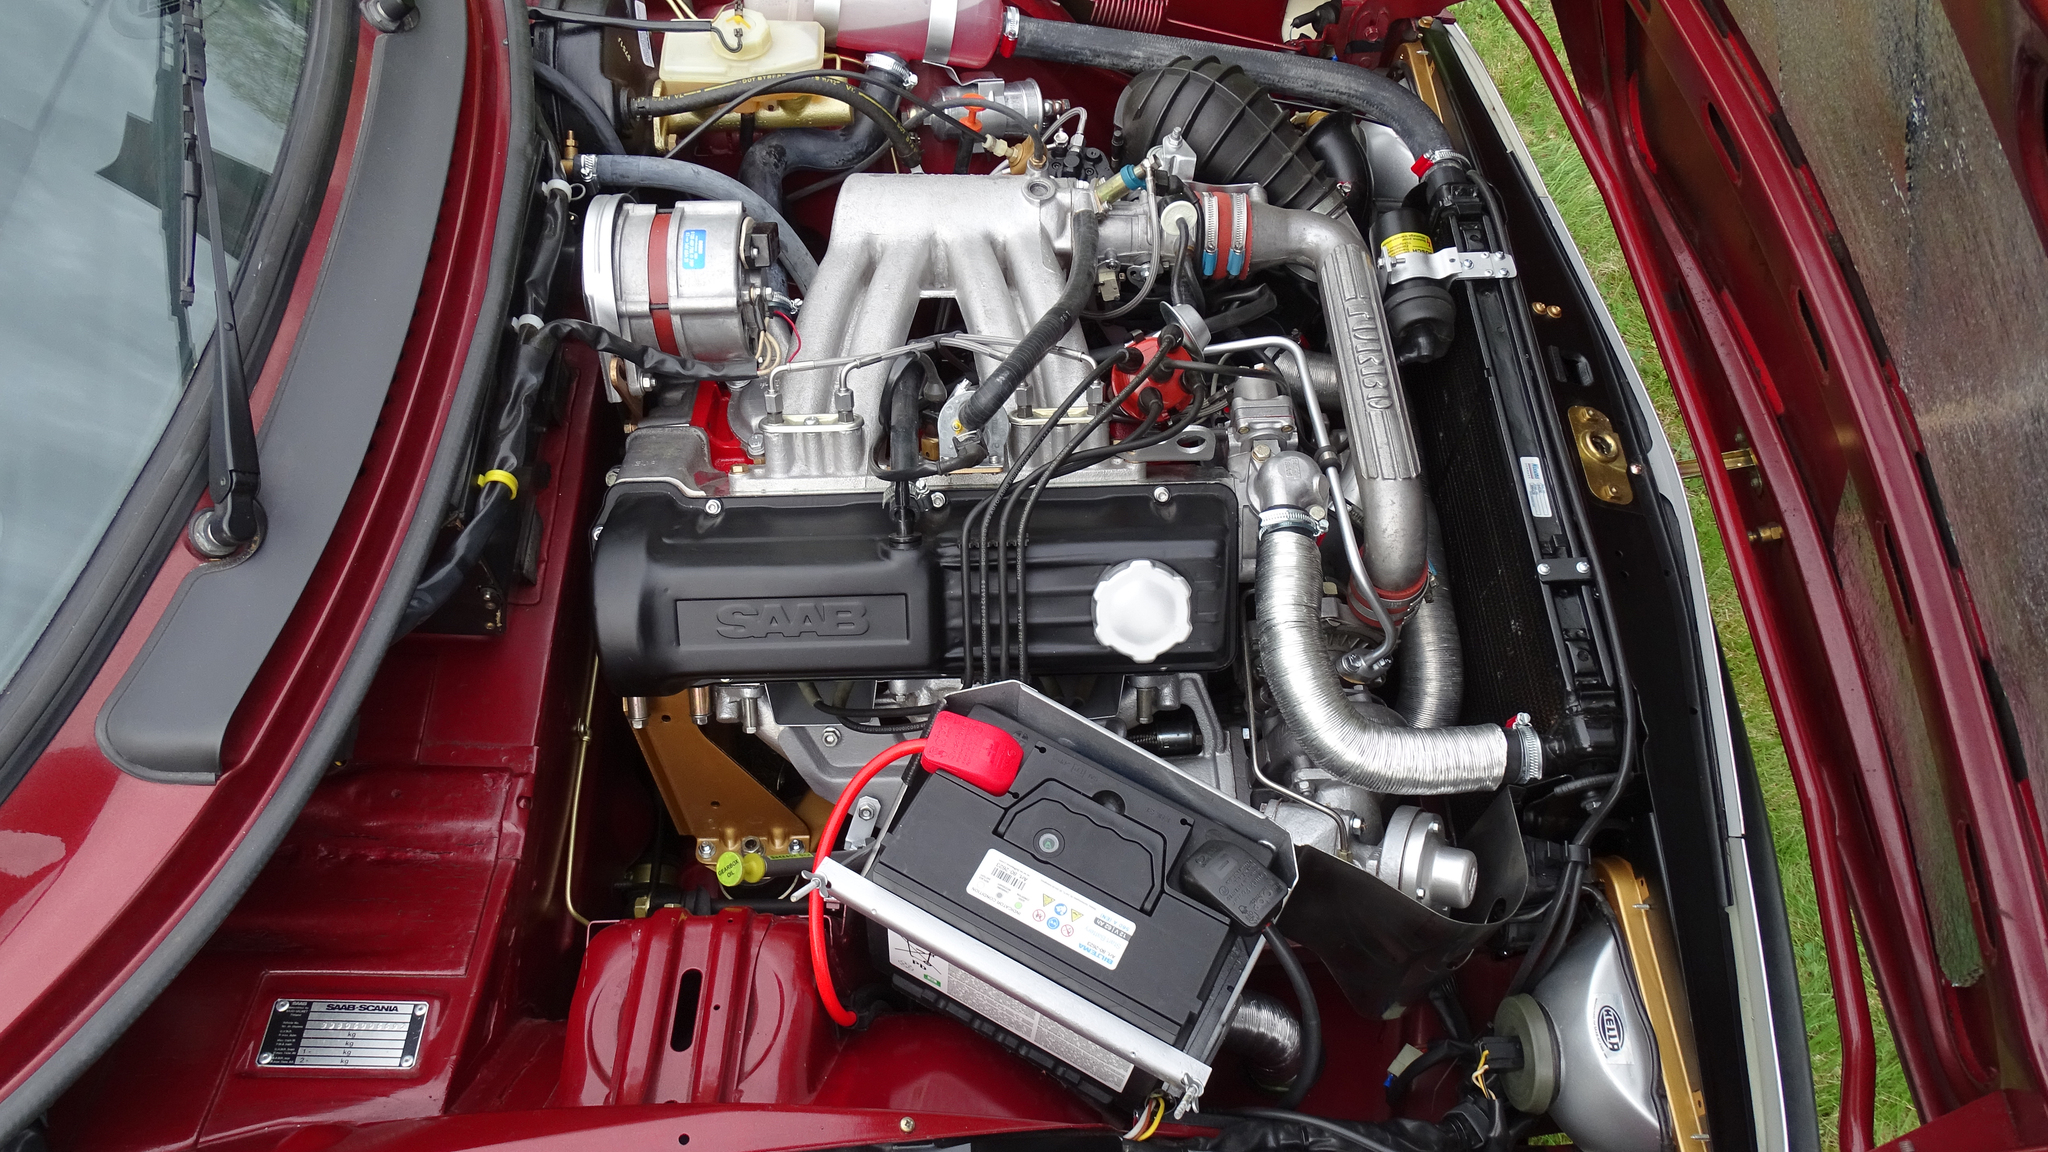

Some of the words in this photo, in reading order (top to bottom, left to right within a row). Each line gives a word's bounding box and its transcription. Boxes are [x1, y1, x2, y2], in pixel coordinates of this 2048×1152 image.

[1348, 301, 1393, 410] TURBO
[717, 602, 870, 639] SAAB
[717, 858, 739, 876] GEARBOX
[1078, 943, 1113, 964] BILTEMA
[1604, 1009, 1620, 1051] HELLA
